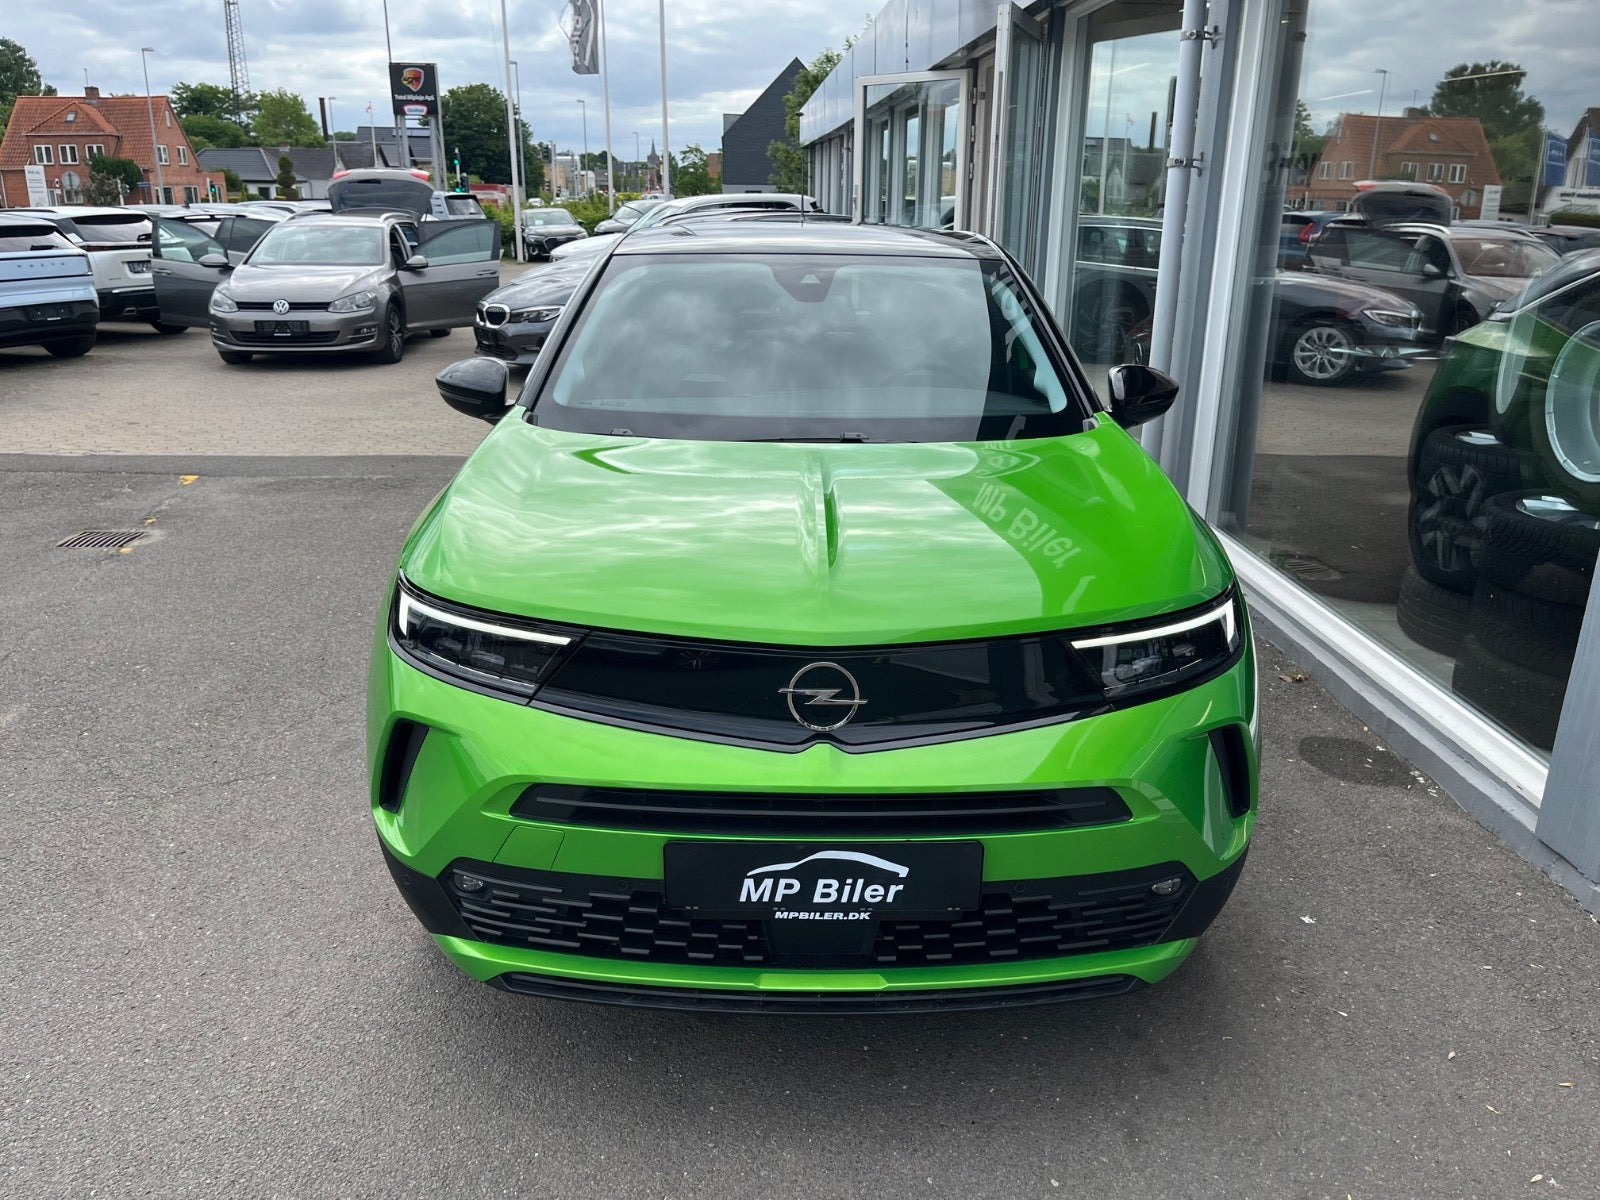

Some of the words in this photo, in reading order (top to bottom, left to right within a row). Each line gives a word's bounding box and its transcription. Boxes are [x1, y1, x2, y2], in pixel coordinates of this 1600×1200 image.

[739, 878, 801, 902] MP
[812, 878, 904, 903] Biler
[774, 911, 872, 920] MPBILER.DK
